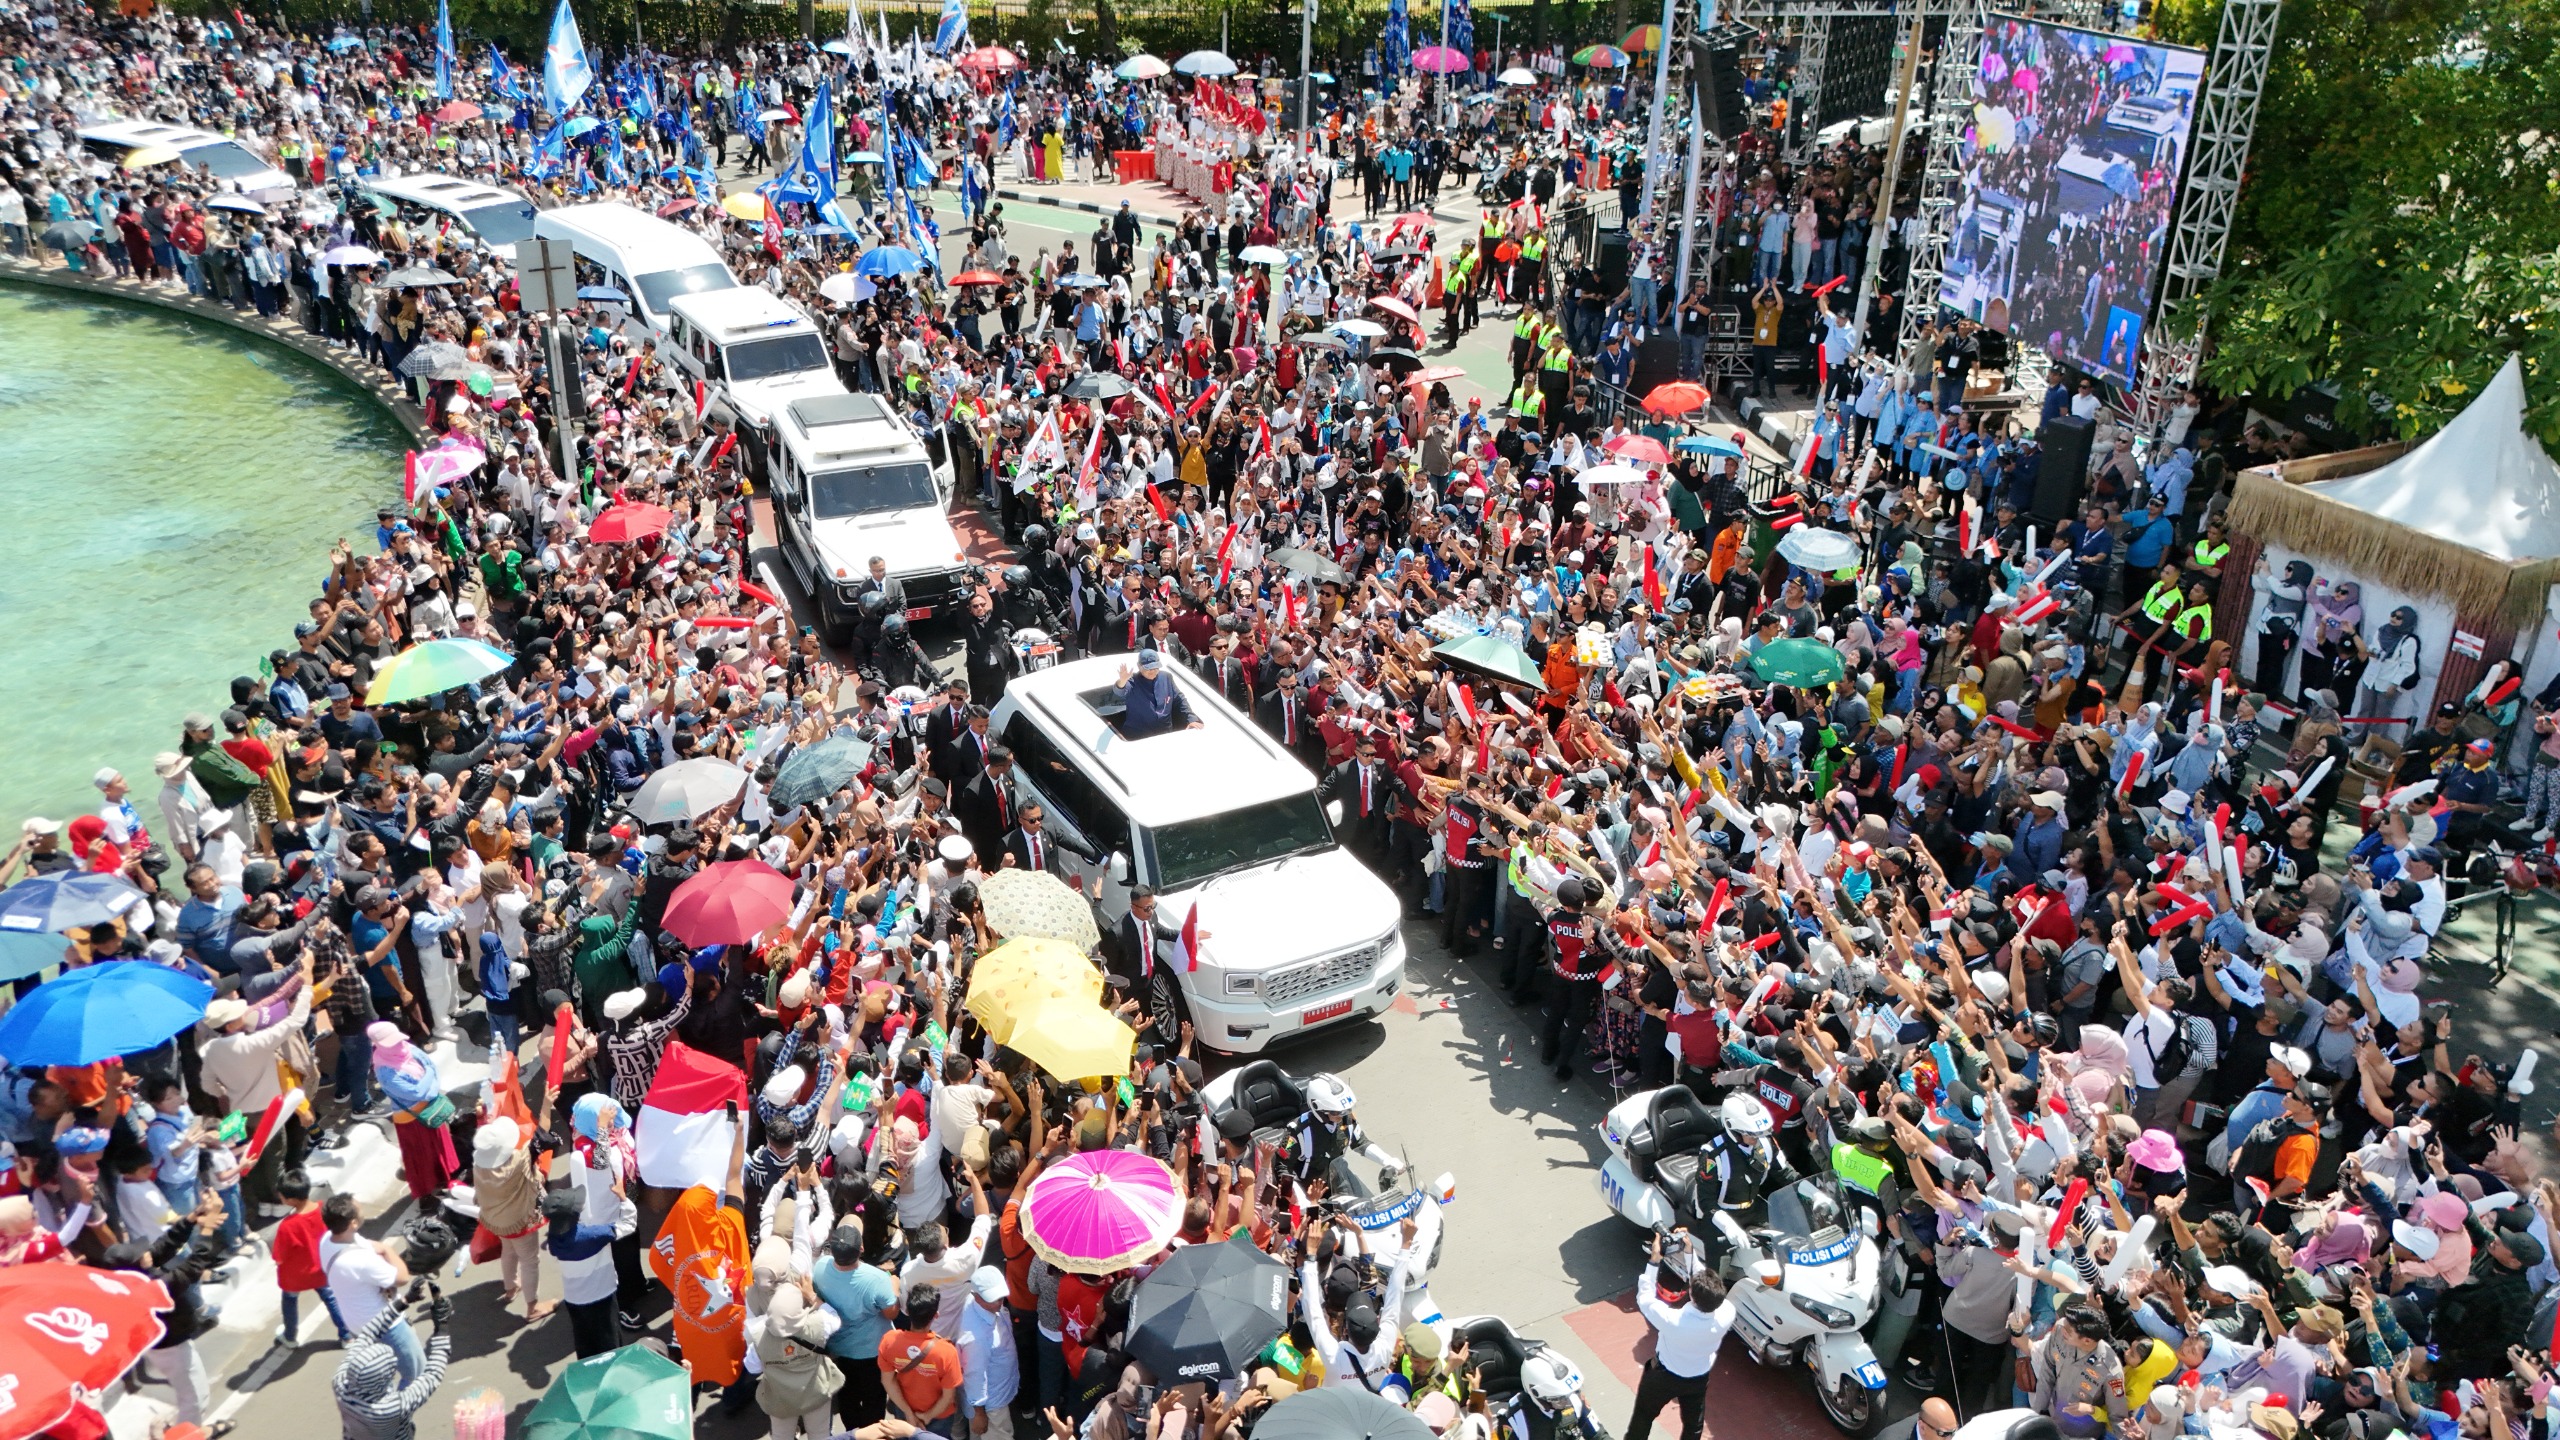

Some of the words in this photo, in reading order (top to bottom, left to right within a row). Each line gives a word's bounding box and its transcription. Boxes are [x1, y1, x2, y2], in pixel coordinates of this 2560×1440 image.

[1449, 807, 1470, 829] POLISI
[1556, 924, 1584, 939] POLIS
[1307, 1000, 1348, 1018] INDONESIA
[1759, 1080, 1793, 1112] POLISI
[1601, 1167, 1625, 1213] PM
[1354, 1210, 1391, 1228] POLISI
[1791, 1247, 1831, 1264] POLISI
[1270, 1274, 1283, 1312] digiroom
[1178, 1361, 1220, 1377] digiroom
[1564, 1374, 1582, 1390] PM
